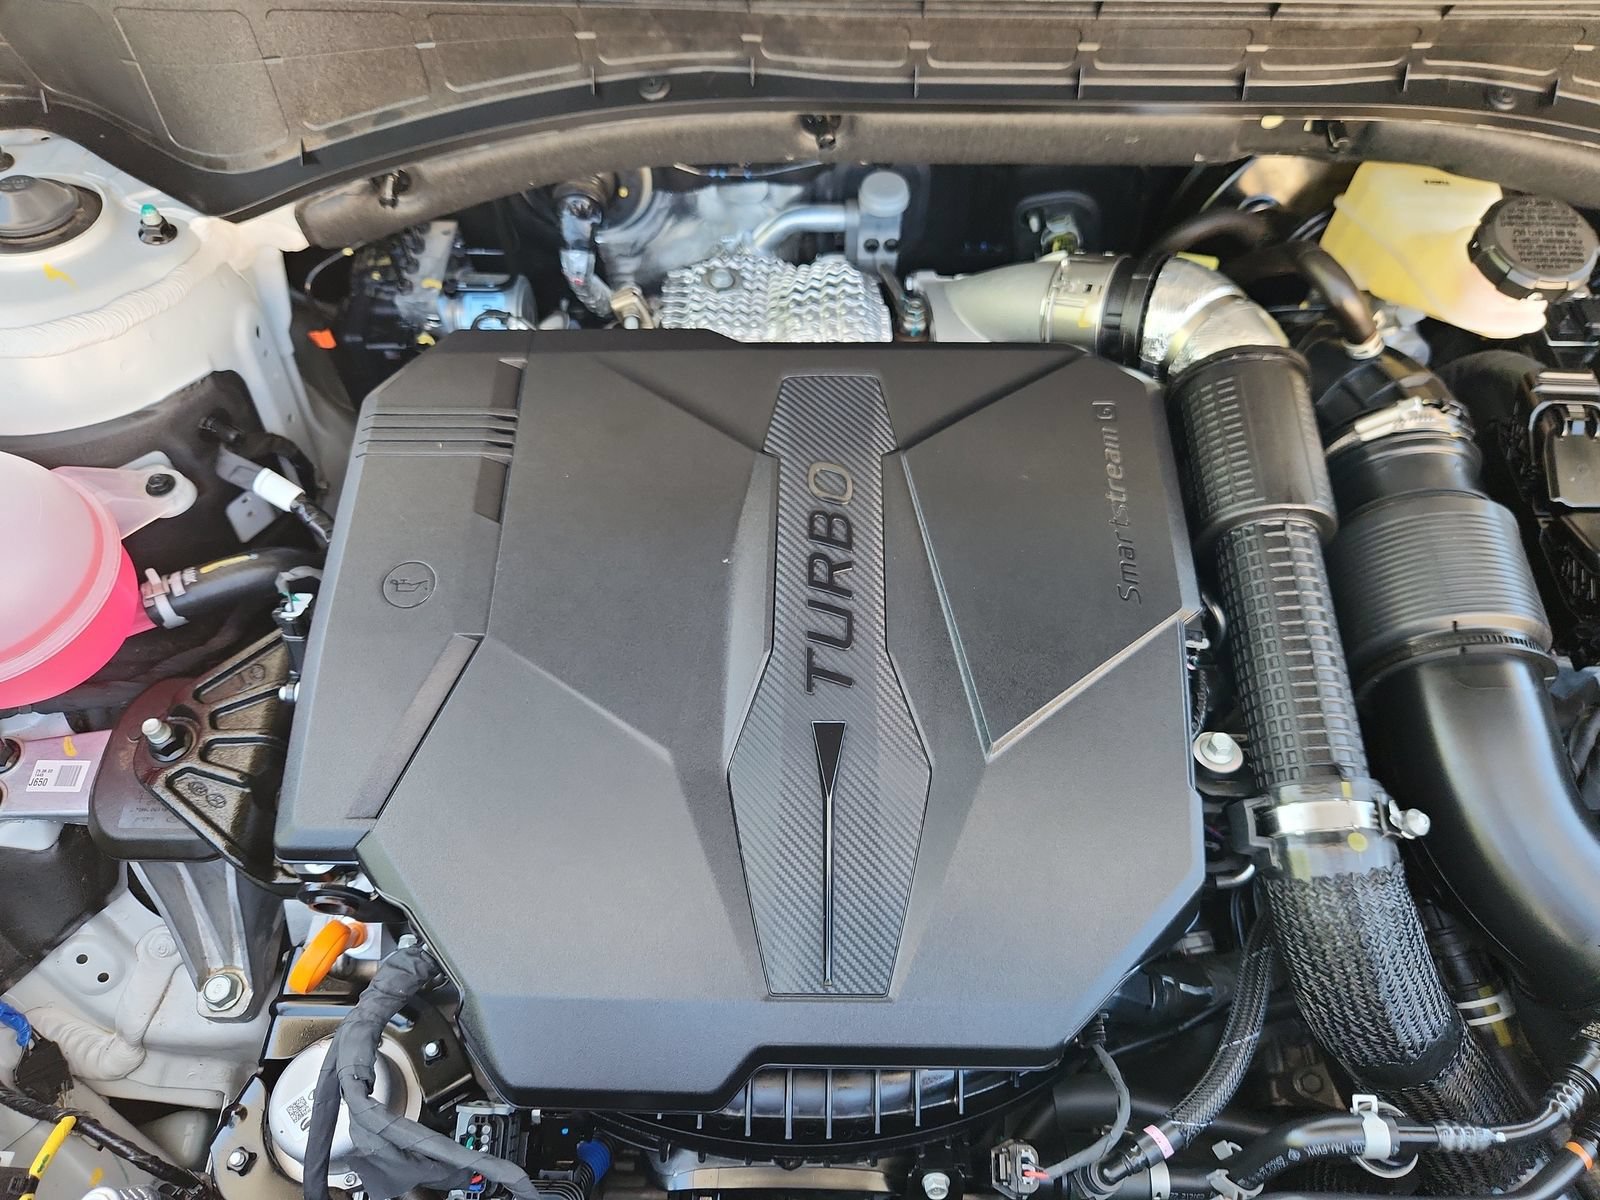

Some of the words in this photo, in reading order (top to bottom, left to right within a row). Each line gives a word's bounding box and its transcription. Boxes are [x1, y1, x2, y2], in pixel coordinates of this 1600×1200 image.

[805, 461, 853, 695] TURBO
[1102, 427, 1142, 605] Smartstream
[28, 777, 48, 787] J650
